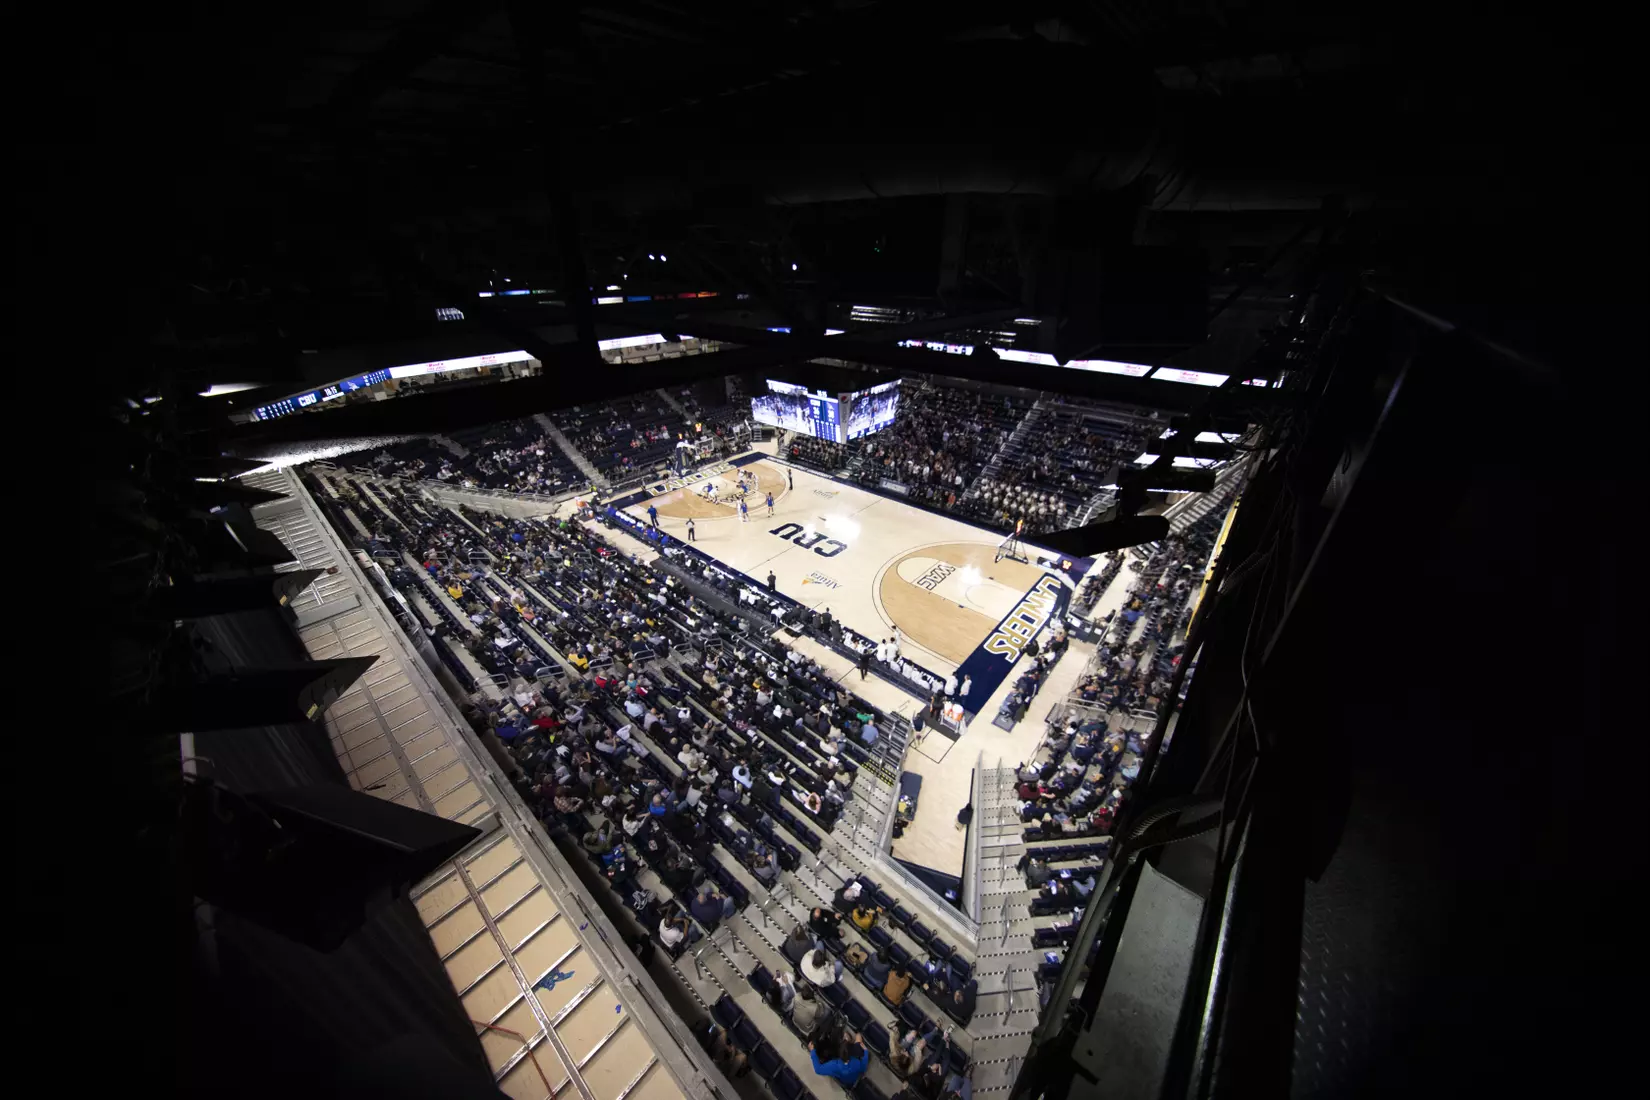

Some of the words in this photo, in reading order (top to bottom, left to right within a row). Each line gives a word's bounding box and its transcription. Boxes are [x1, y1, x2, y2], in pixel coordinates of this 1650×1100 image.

[298, 393, 317, 407] CBU
[769, 522, 848, 558] CBU
[811, 572, 844, 590] Altura
[917, 564, 956, 591] WAC
[983, 574, 1062, 664] LANCERS
